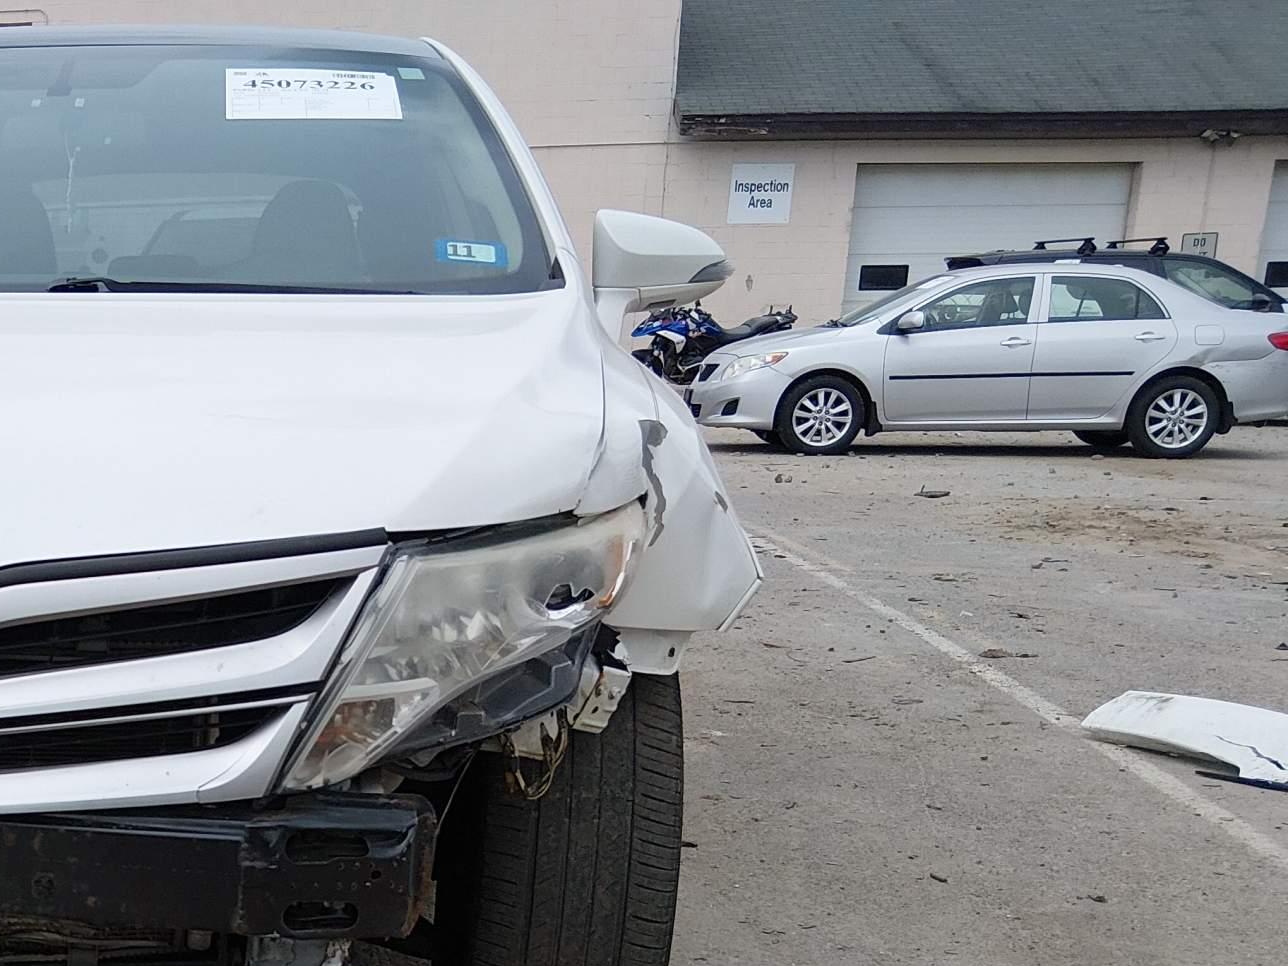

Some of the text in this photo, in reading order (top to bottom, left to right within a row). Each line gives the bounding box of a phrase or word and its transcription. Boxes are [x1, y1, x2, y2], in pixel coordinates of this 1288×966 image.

[243, 79, 375, 90] 45073226
[734, 179, 789, 195] Inspection
[748, 195, 773, 208] Area
[1193, 237, 1207, 248] DO
[447, 244, 476, 258] 11
